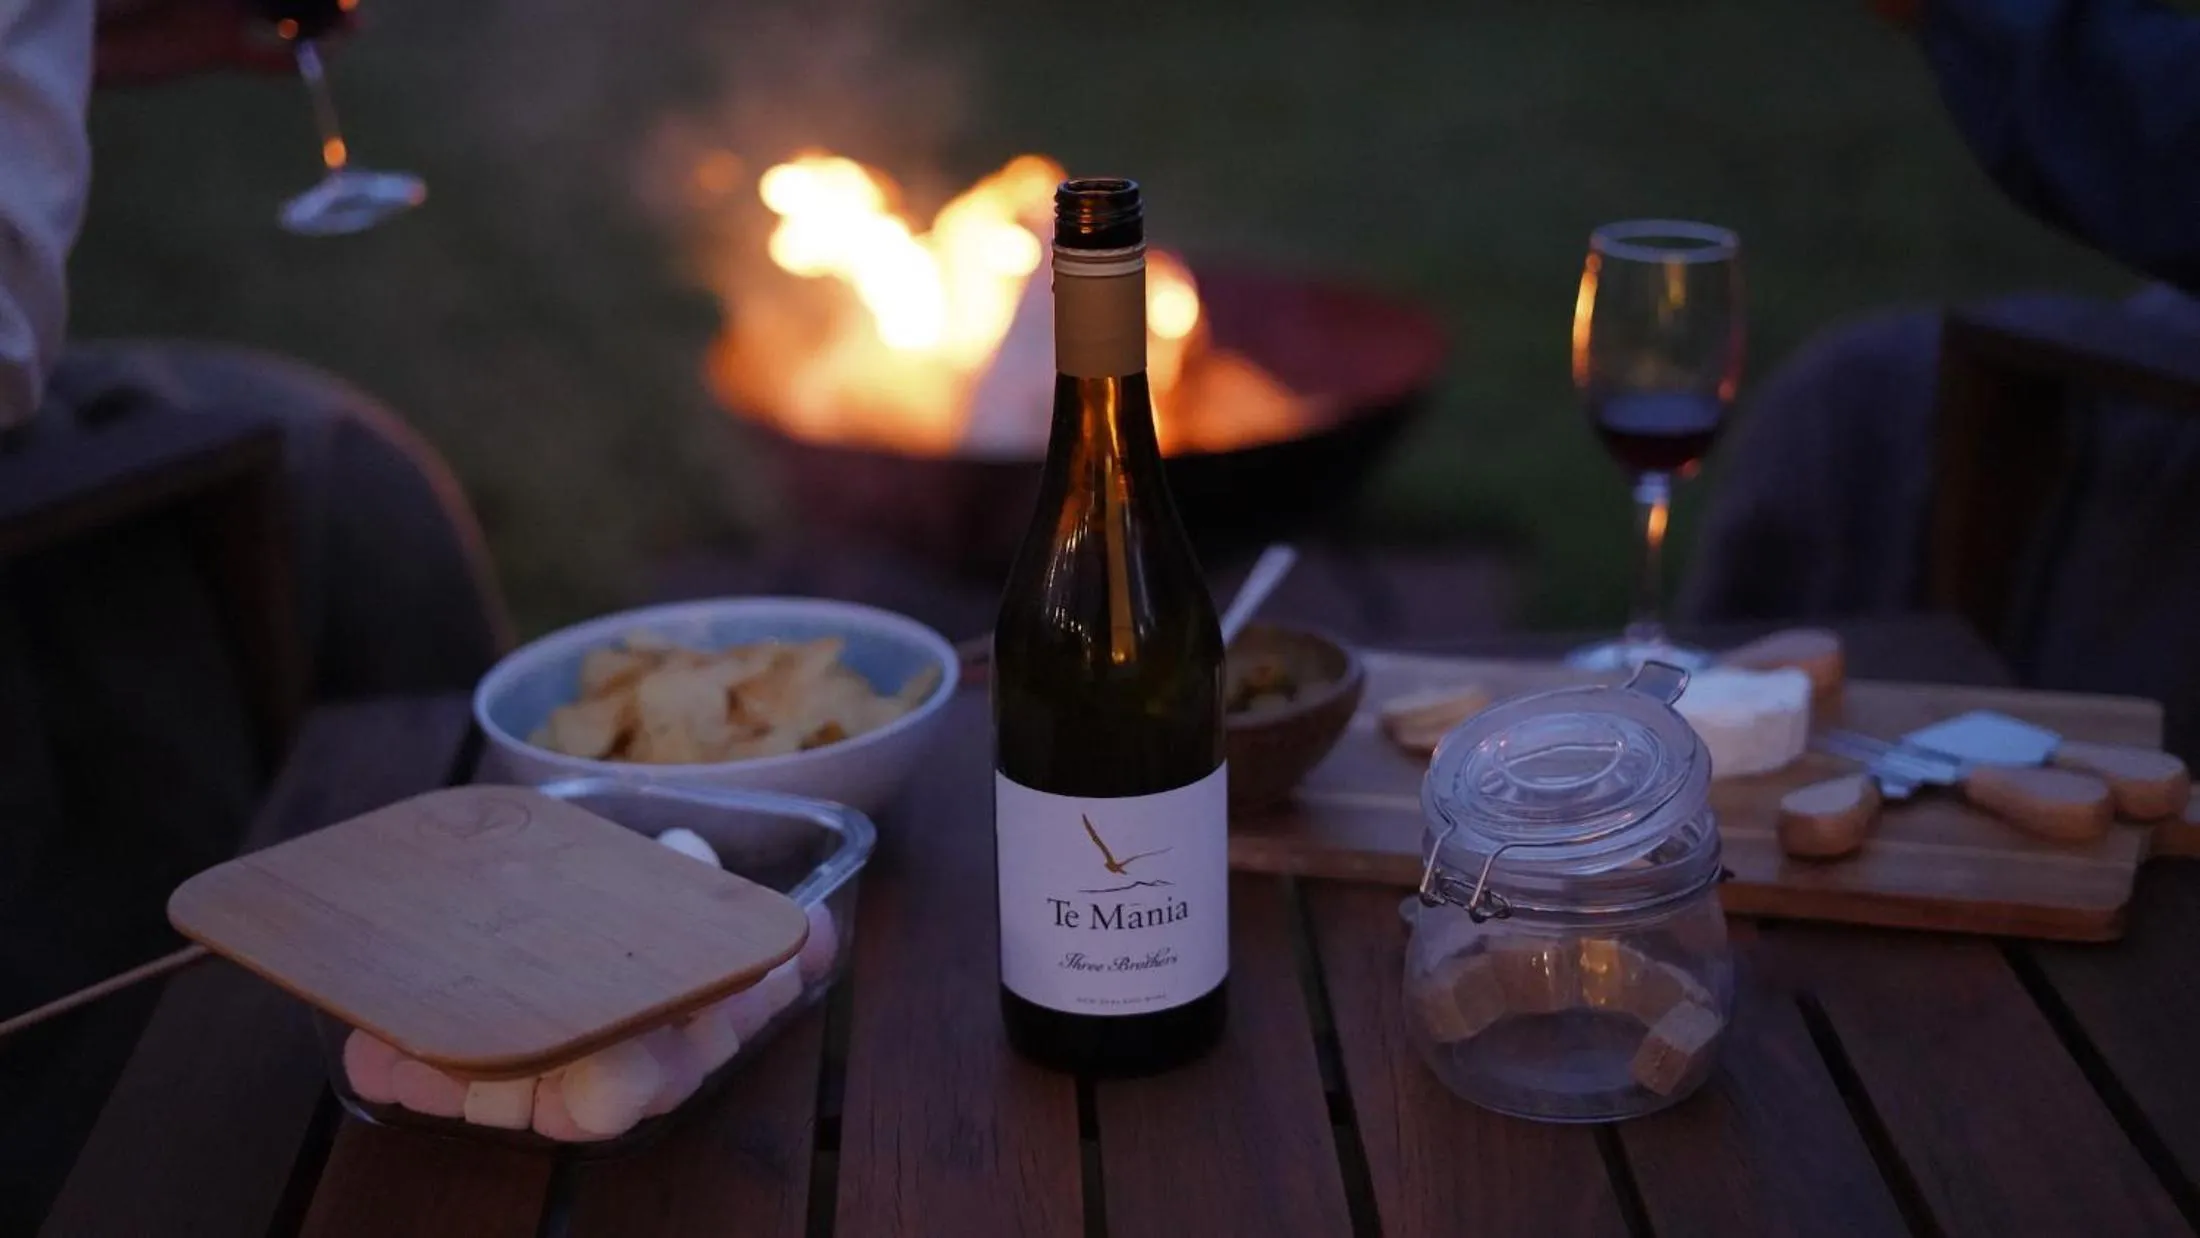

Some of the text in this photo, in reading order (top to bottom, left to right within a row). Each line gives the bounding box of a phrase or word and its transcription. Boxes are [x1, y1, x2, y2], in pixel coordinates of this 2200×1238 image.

[1046, 898, 1080, 928] Te
[1058, 947, 1178, 972] Three Brothers
